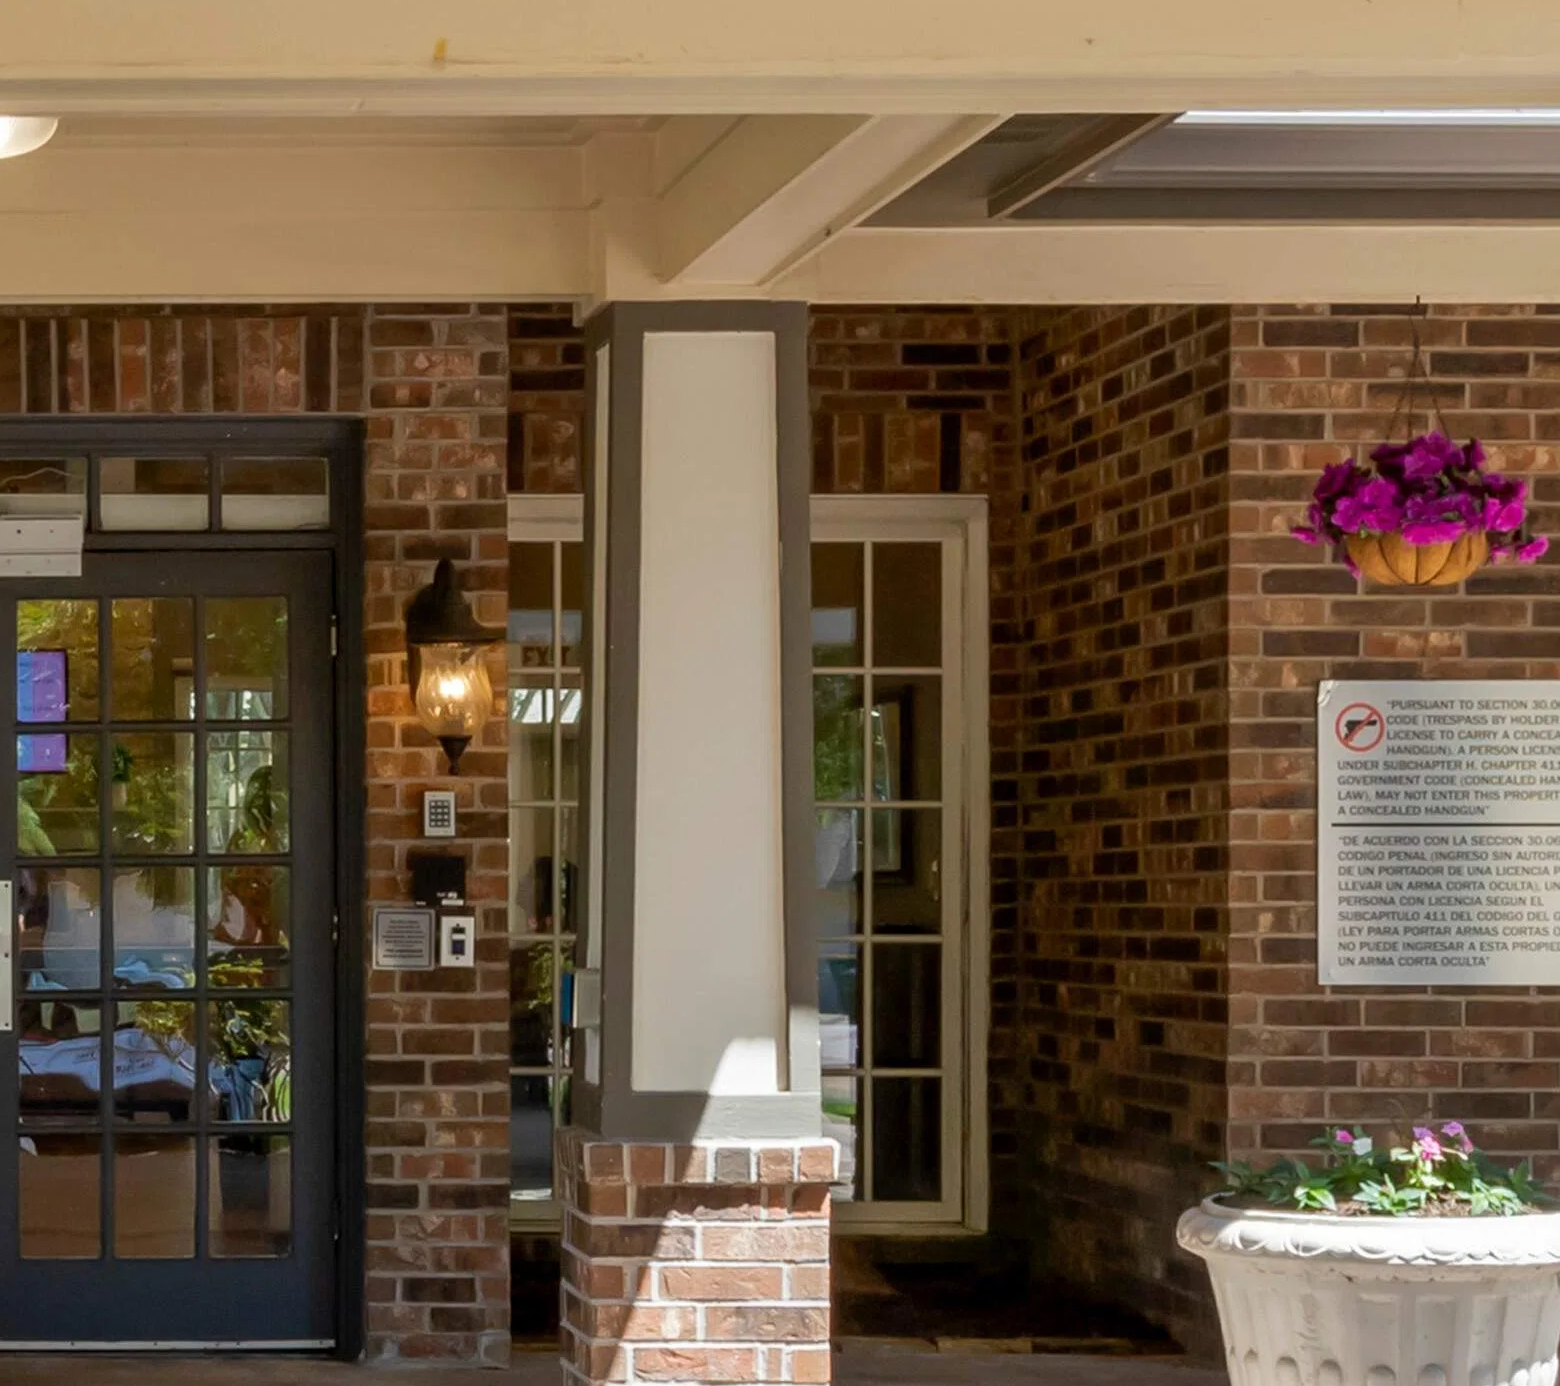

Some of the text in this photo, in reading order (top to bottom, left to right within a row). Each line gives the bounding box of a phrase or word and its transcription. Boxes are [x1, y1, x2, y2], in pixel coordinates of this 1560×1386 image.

[522, 646, 570, 667] EXT
[1460, 700, 1474, 710] TO
[1478, 700, 1528, 710] SECTION
[1386, 715, 1418, 725] CODE
[1422, 715, 1488, 725] (TRESPASS
[1492, 715, 1507, 725] BY
[1510, 715, 1559, 725] HOLDER
[1386, 730, 1435, 740] LICENSE
[1440, 730, 1454, 740] TO
[1458, 730, 1498, 740] CARRY
[1502, 730, 1510, 740] A
[1458, 745, 1466, 755] A
[1469, 745, 1519, 755] PERSON
[1338, 761, 1379, 771] UNDER
[1383, 761, 1462, 771] SUBCHAPTER
[1481, 761, 1537, 771] CHAPTER
[1338, 775, 1421, 786] GOVERNMENT
[1424, 775, 1456, 786] CODE
[1460, 775, 1536, 786] (CONCEALED
[1376, 791, 1403, 801] MAY
[1404, 791, 1428, 801] NOT
[1432, 791, 1470, 801] ENTER
[1474, 791, 1501, 801] THIS
[1338, 805, 1346, 816] A
[1350, 805, 1421, 816] CONCEALED
[1362, 835, 1420, 846] ACUERDO
[1424, 835, 1449, 846] CON
[1453, 835, 1467, 846] LA
[1471, 835, 1523, 846] SECCION
[1338, 851, 1385, 862] CODIGO
[1388, 851, 1427, 862] PENAL
[1431, 851, 1489, 862] (INGRESO
[1492, 851, 1512, 862] SIN
[1338, 866, 1355, 876] DE
[1358, 866, 1375, 876] UN
[1378, 866, 1444, 876] PORTADOR
[1448, 866, 1463, 876] DE
[1467, 866, 1492, 876] UNA
[1496, 866, 1550, 876] LICENCIA
[1338, 881, 1383, 891] LLEVAR
[1386, 881, 1403, 891] UN
[1406, 881, 1442, 891] ARMA
[1446, 881, 1486, 891] CORTA
[1338, 896, 1545, 906] PERSONA CON LICENCIA SEGUN EL
[1338, 911, 1420, 921] SUBCAPITULO
[1424, 911, 1447, 921] 411
[1450, 911, 1473, 921] DEL
[1476, 911, 1524, 921] CODIGO
[1527, 911, 1550, 921] DEL
[1338, 926, 1365, 937] (LEY
[1368, 926, 1400, 937] PARA
[1404, 926, 1452, 937] PORTAR
[1456, 926, 1499, 937] ARMAS
[1502, 926, 1549, 937] CORTAS
[1338, 941, 1356, 952] NO
[1359, 941, 1399, 952] PUEDE
[1402, 941, 1464, 952] INGRESAR
[1468, 941, 1476, 952] A
[1480, 941, 1509, 952] ESTA
[1338, 957, 1355, 967] UN
[1358, 957, 1395, 967] ARMA
[1398, 957, 1438, 967] CORTA
